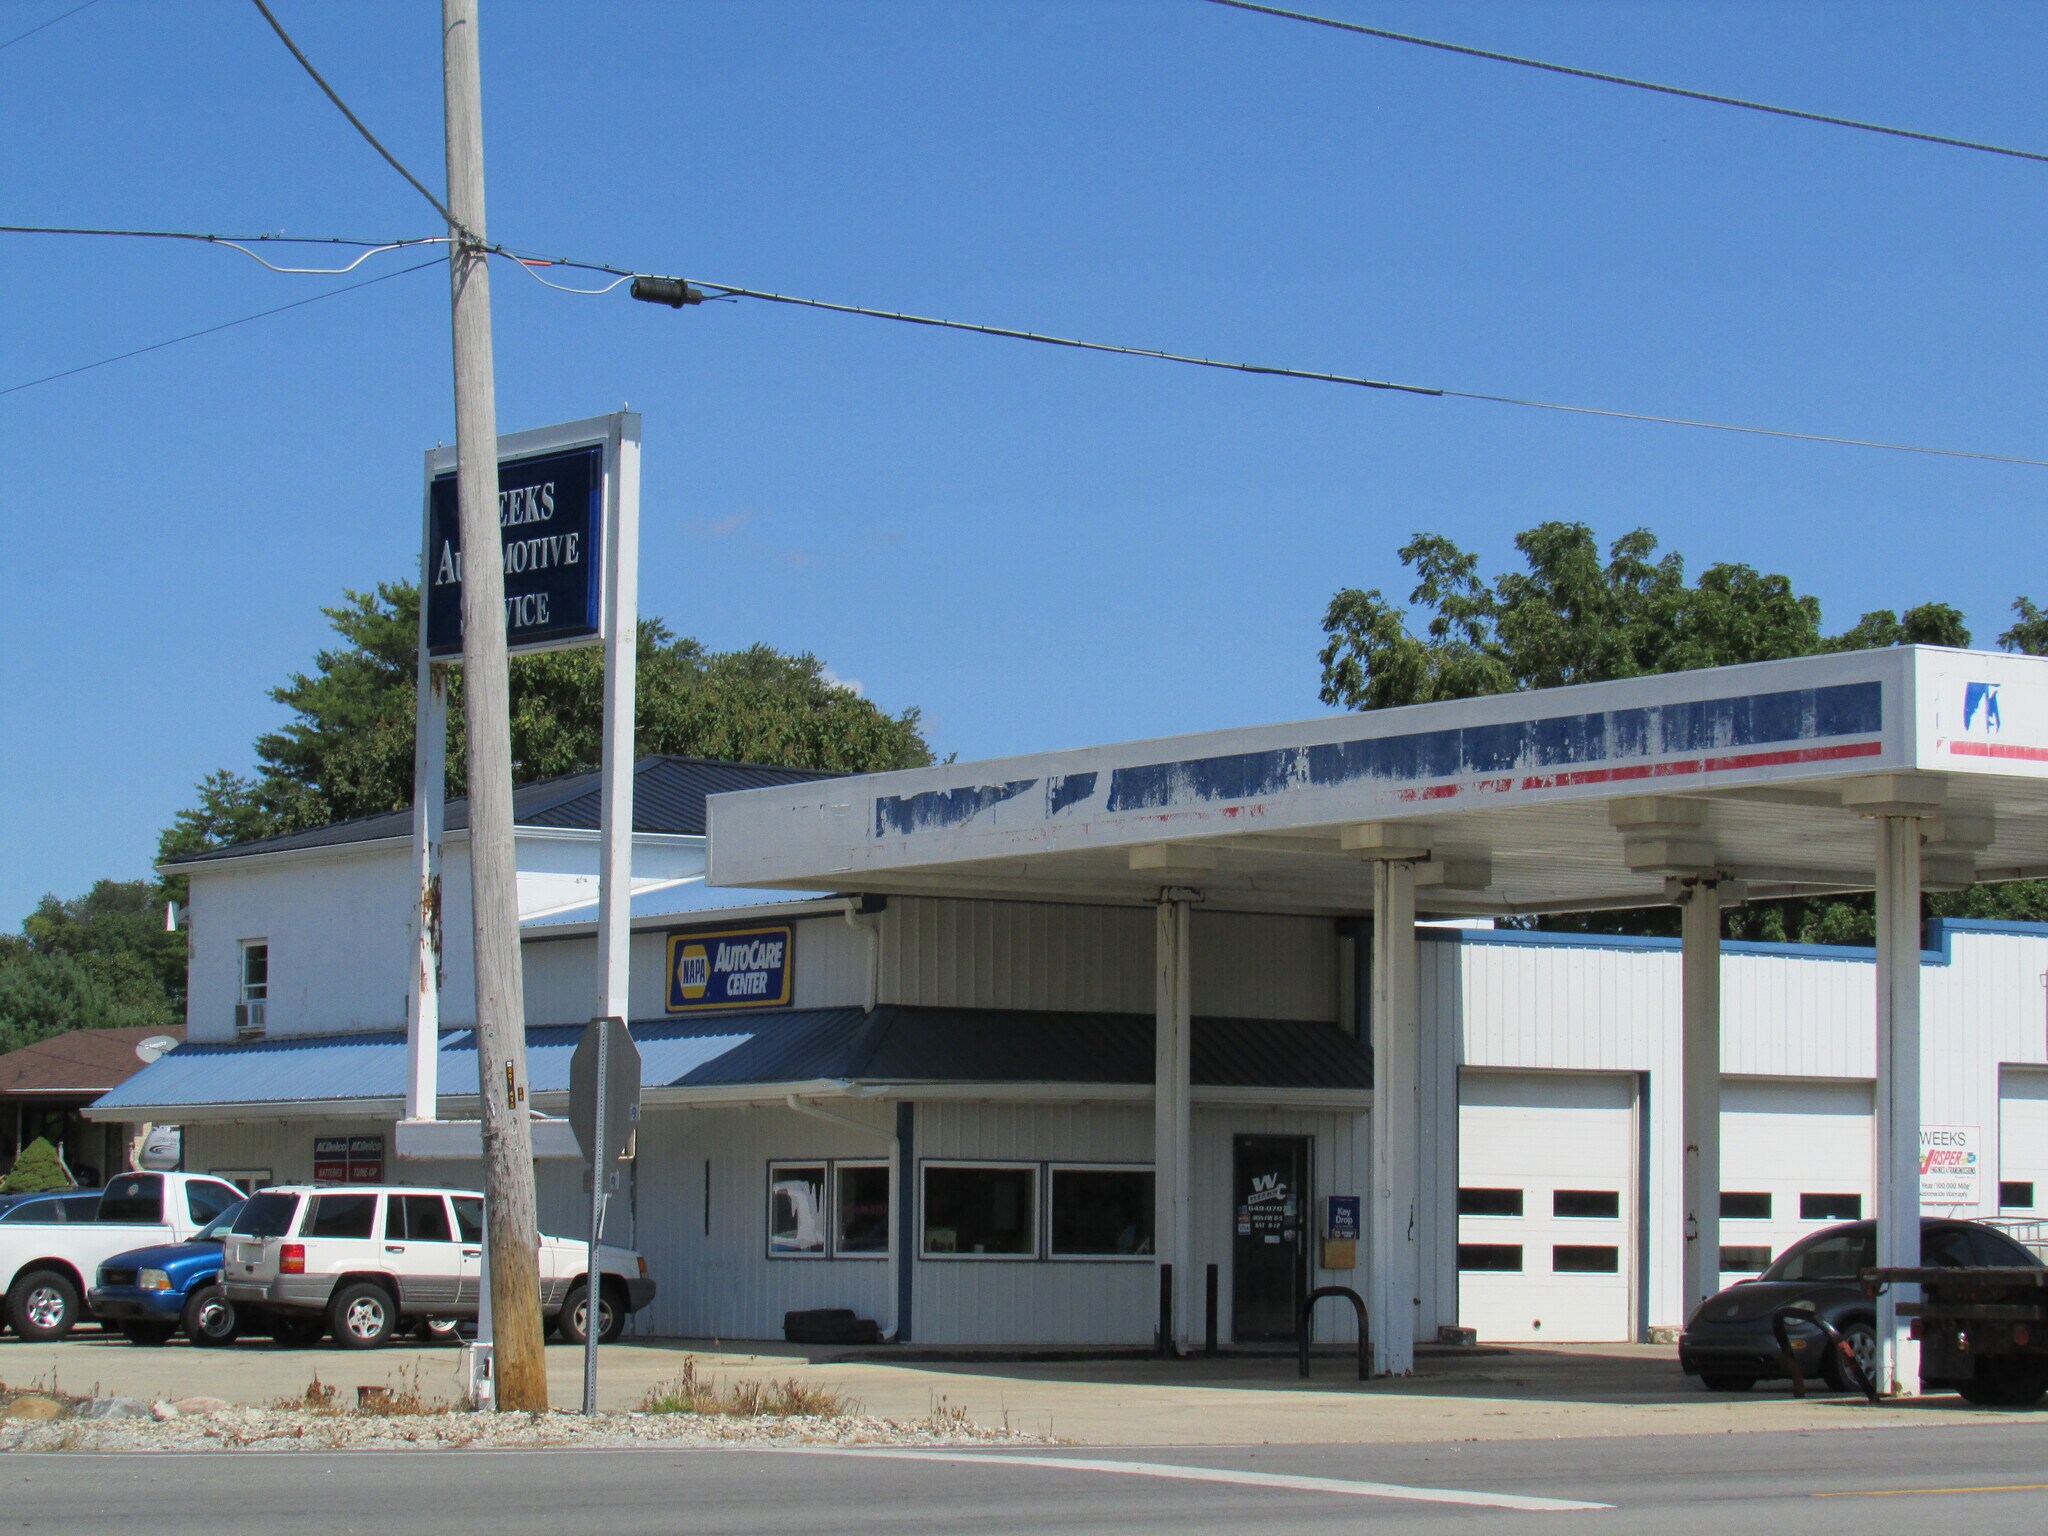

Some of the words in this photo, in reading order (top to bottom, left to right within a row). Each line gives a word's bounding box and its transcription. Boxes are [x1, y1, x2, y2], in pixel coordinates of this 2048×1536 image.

[499, 481, 555, 528] EEKS
[435, 532, 579, 586] AMOTIVE
[683, 958, 706, 985] NAPA
[727, 971, 768, 996] CENTER
[1919, 1131, 1966, 1147] WEEKS
[1919, 1149, 1963, 1175] JASPER
[1335, 1216, 1353, 1225] Drop
[1337, 1207, 1351, 1218] Key
